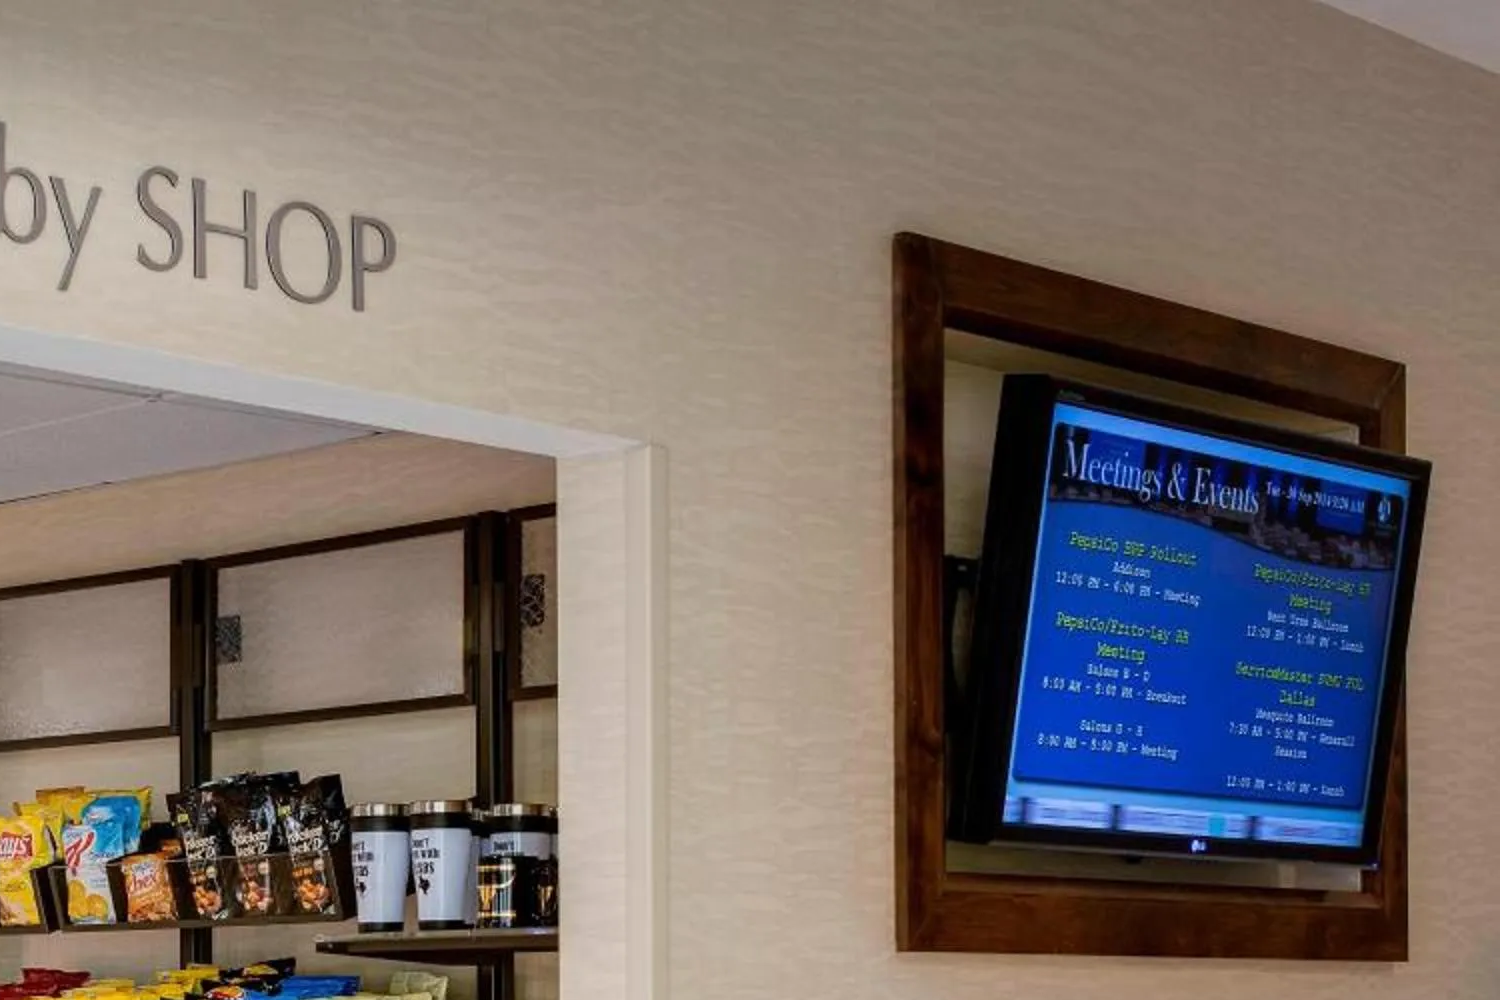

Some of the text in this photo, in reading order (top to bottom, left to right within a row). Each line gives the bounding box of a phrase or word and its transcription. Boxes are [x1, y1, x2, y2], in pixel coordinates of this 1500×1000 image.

[136, 166, 397, 312] SHOP
[1063, 440, 1261, 515] Meetings & Events
[1069, 531, 1119, 552] PepsiCo
[1096, 641, 1146, 664] Meeting
